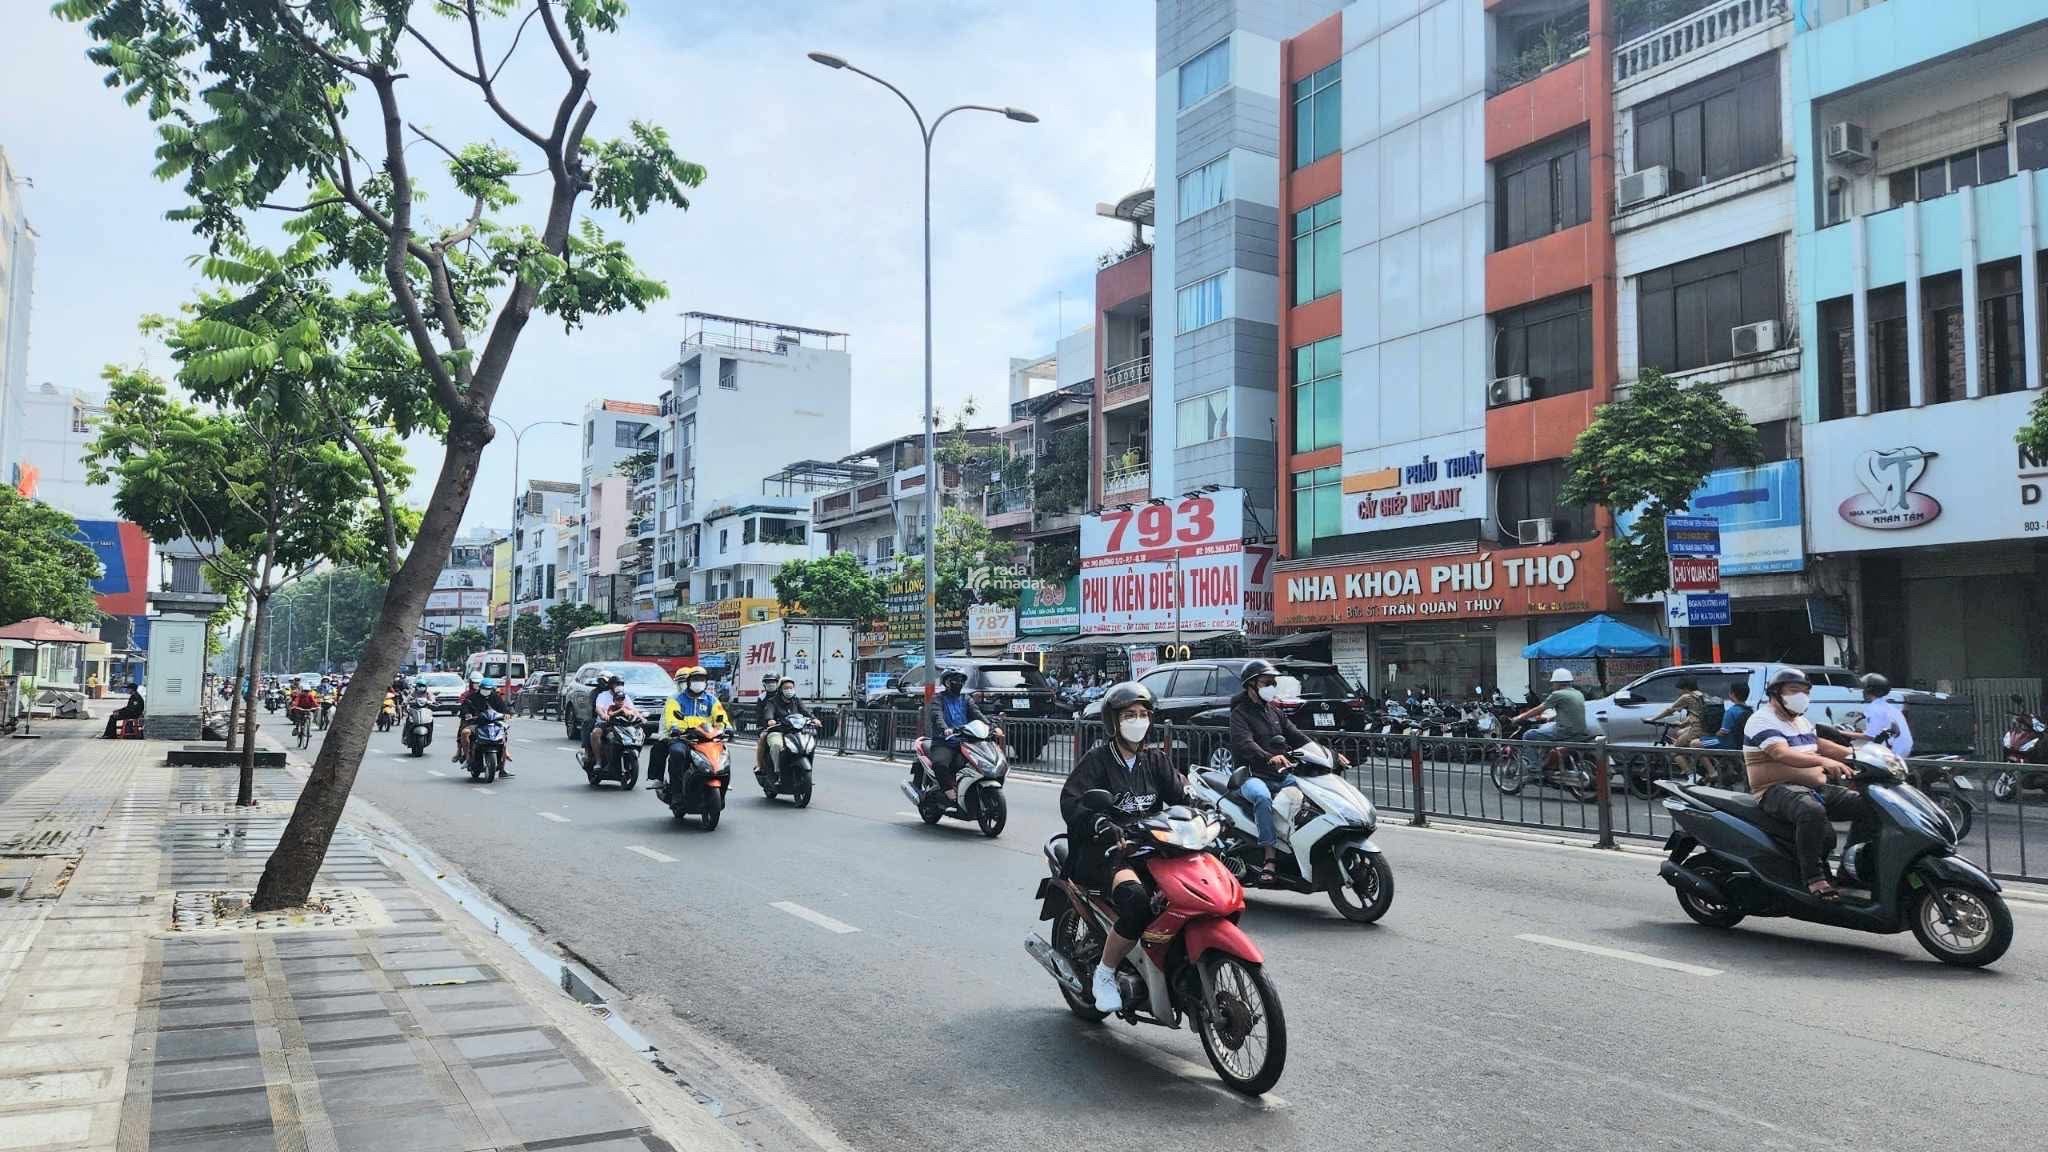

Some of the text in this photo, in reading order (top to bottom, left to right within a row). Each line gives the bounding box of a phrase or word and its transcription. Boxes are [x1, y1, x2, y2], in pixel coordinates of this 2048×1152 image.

[1445, 450, 1485, 480] THUẬT
[1380, 491, 1408, 517] GHÉP
[1411, 488, 1462, 513] IMPLANT
[1101, 497, 1215, 553] 793
[1082, 562, 1238, 622] PHỤ KIỆN ĐIỆN THOẠI
[1287, 575, 1338, 603] NHA
[1345, 568, 1422, 599] KHOA
[1431, 552, 1493, 594] PHÚ
[976, 615, 1009, 630] 787
[747, 641, 777, 665] HTL
